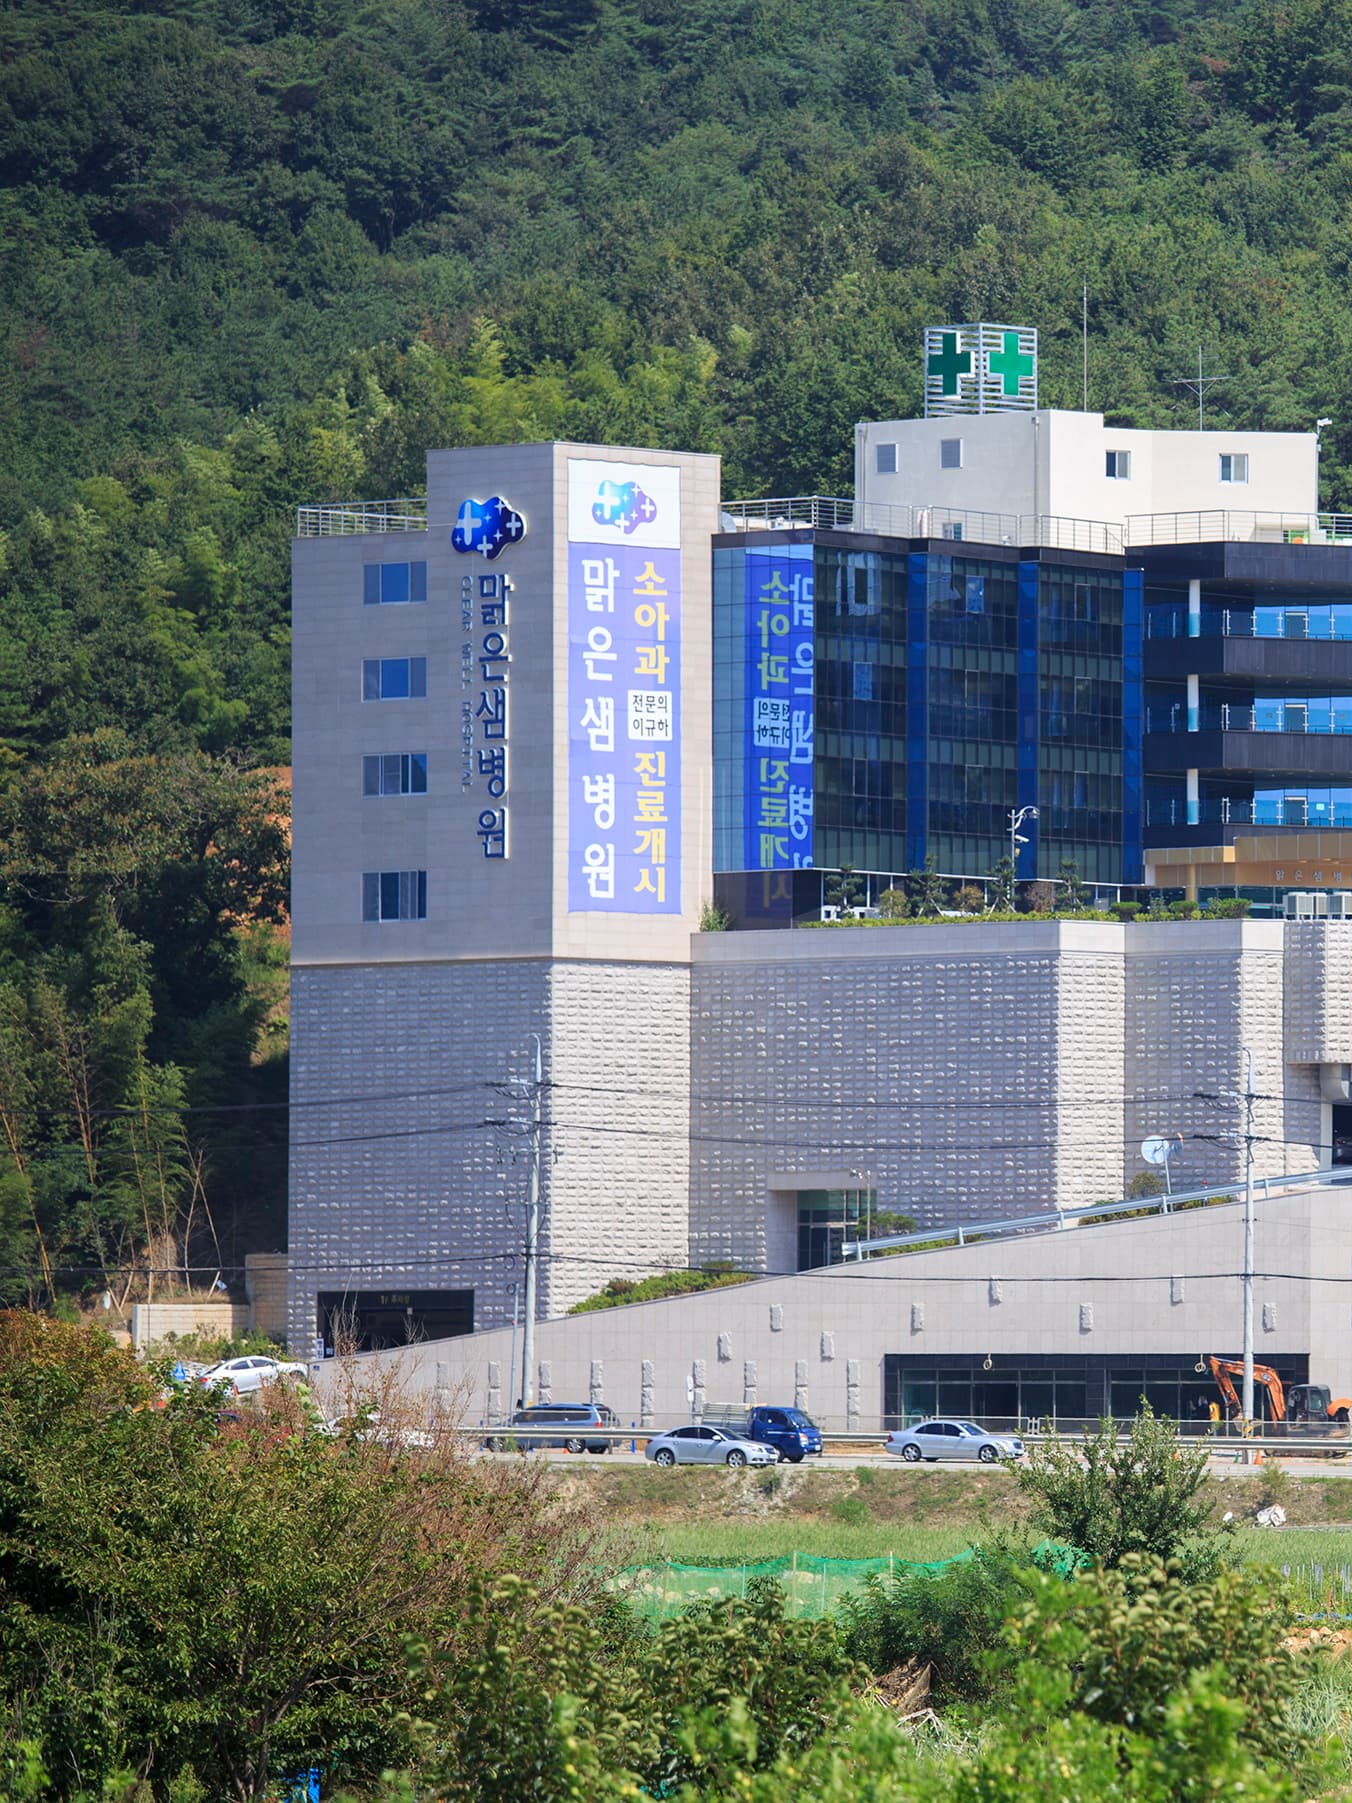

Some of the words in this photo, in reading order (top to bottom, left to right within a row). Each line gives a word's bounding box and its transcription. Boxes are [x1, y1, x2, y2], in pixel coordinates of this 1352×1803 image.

[461, 576, 473, 632] CLEAR
[633, 561, 670, 684] 소아과
[461, 642, 473, 689] WELL
[632, 694, 667, 713] 전문의
[461, 701, 473, 793] HOSPITAL
[476, 573, 514, 859] 맑은샘병원
[580, 557, 620, 899] 맑은샘병원
[632, 718, 669, 736] 이규하
[633, 751, 669, 904] 진료개시
